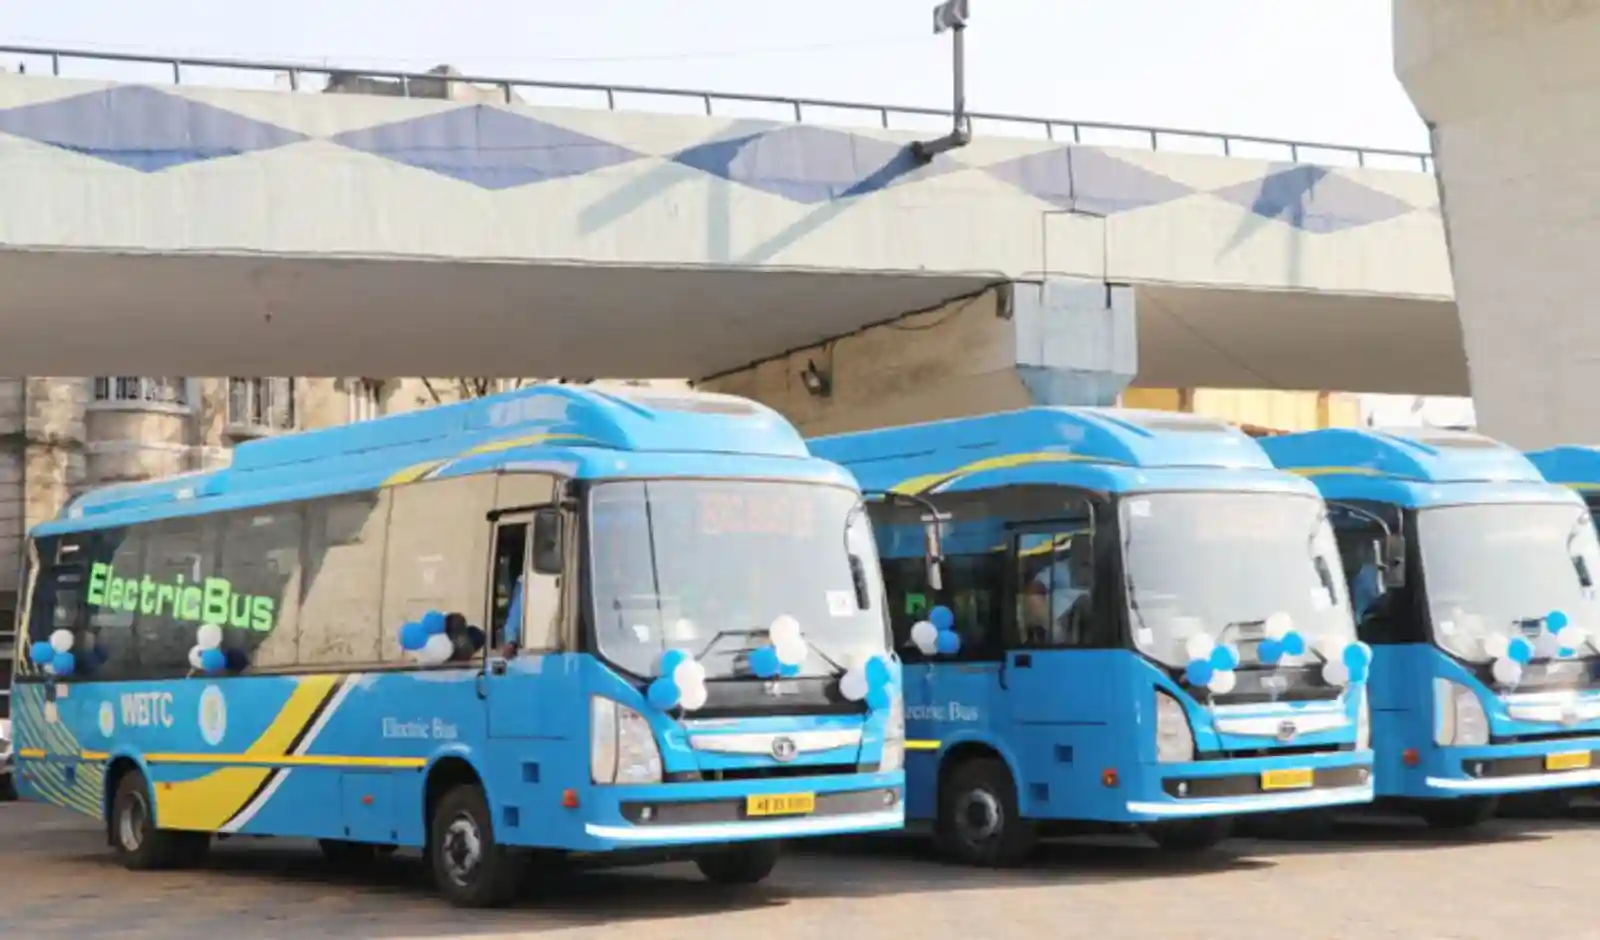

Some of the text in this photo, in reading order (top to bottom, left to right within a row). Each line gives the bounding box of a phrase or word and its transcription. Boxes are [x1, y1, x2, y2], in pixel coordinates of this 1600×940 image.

[121, 692, 174, 728] WBTC
[949, 701, 979, 721] Bus
[381, 716, 458, 739] Electric Bus
